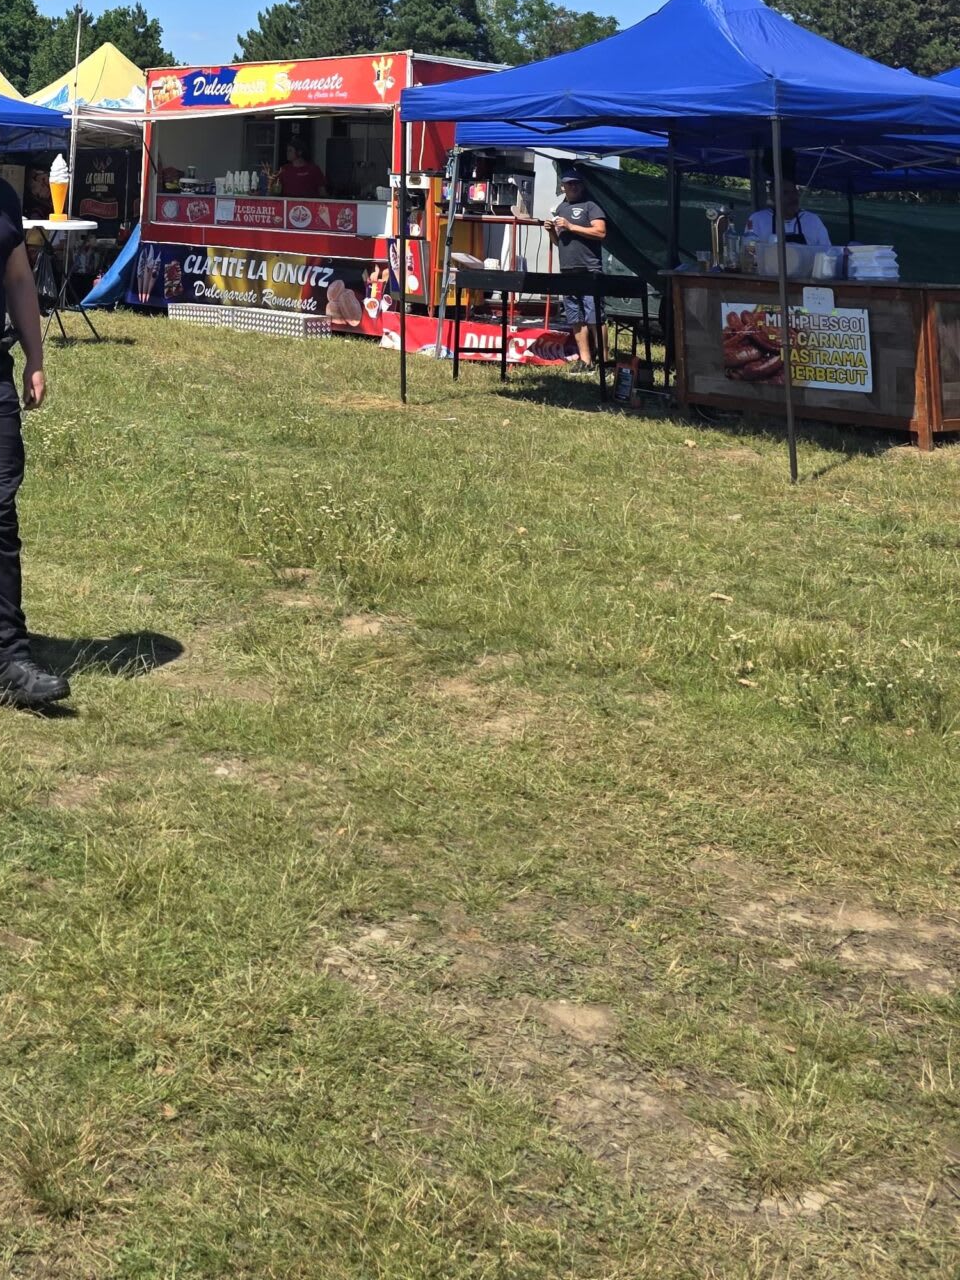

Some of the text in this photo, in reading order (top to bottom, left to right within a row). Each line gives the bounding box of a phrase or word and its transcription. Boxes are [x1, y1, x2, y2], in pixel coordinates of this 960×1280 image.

[184, 254, 334, 288] CLATITE LA ONUTZ
[260, 288, 318, 311] Romaneste
[797, 331, 867, 351] CARNATI
